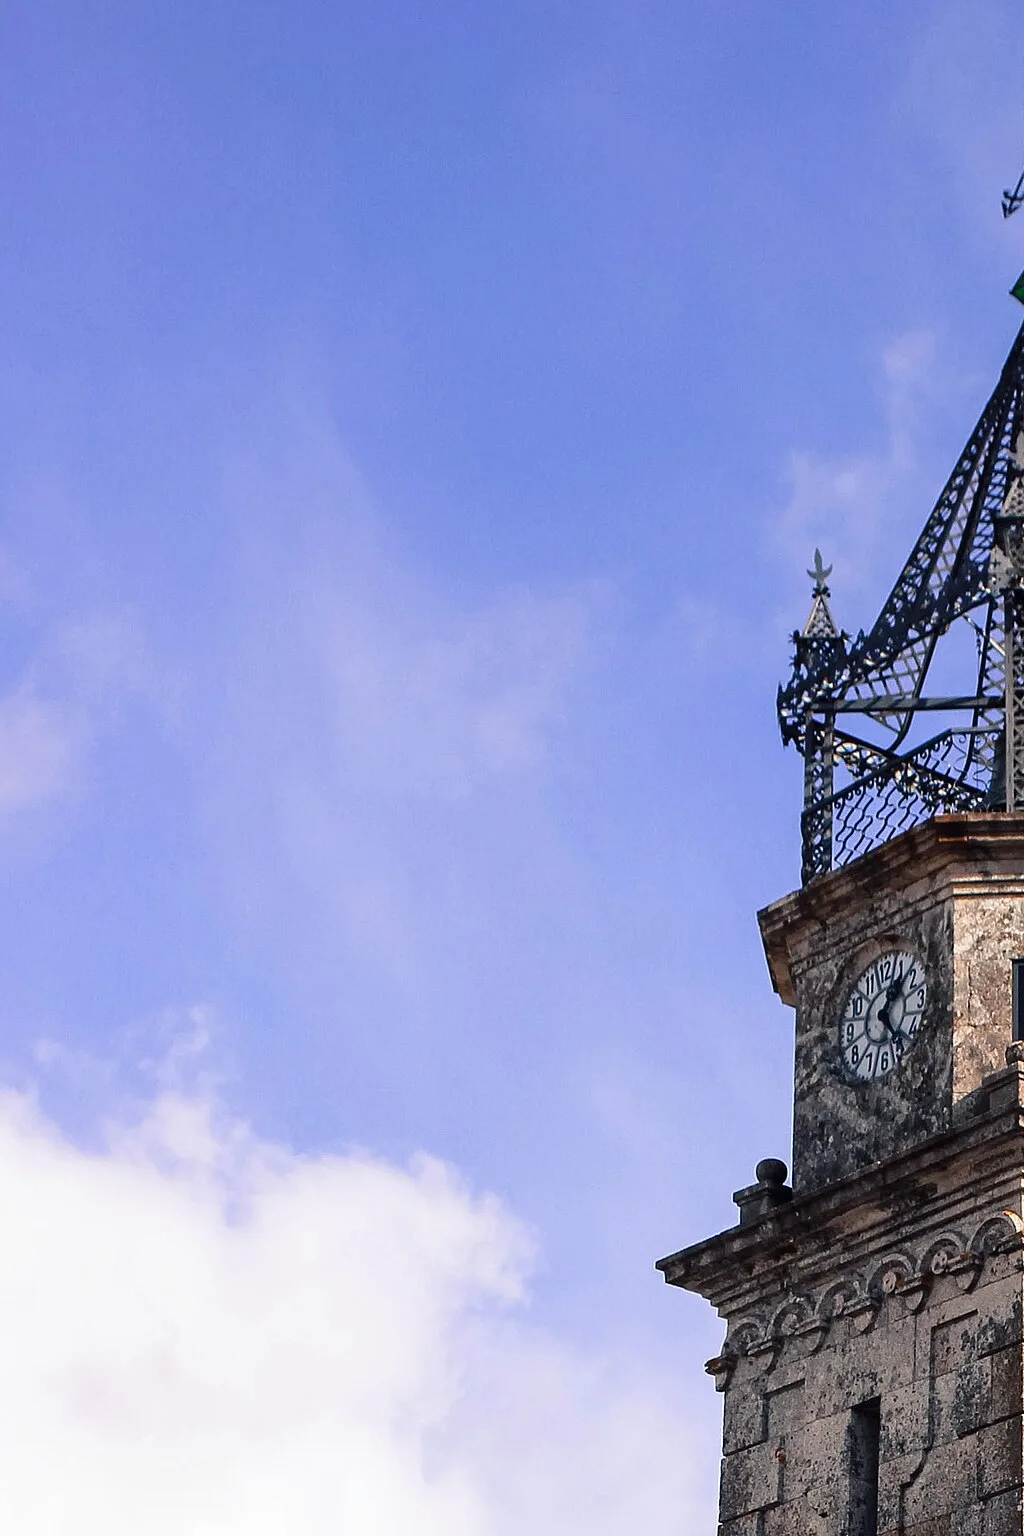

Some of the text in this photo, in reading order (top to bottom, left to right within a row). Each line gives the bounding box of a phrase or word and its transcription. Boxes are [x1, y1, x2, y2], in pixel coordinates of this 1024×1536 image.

[880, 961, 891, 983] 12
[910, 969, 917, 989] 2
[866, 975, 875, 996] 11
[852, 997, 863, 1018] 10
[917, 989, 924, 1009] 3
[847, 1024, 855, 1043] 9
[909, 1016, 917, 1036] 4
[851, 1045, 859, 1065] 8
[866, 1052, 872, 1072] 7
[881, 1052, 889, 1071] 6
